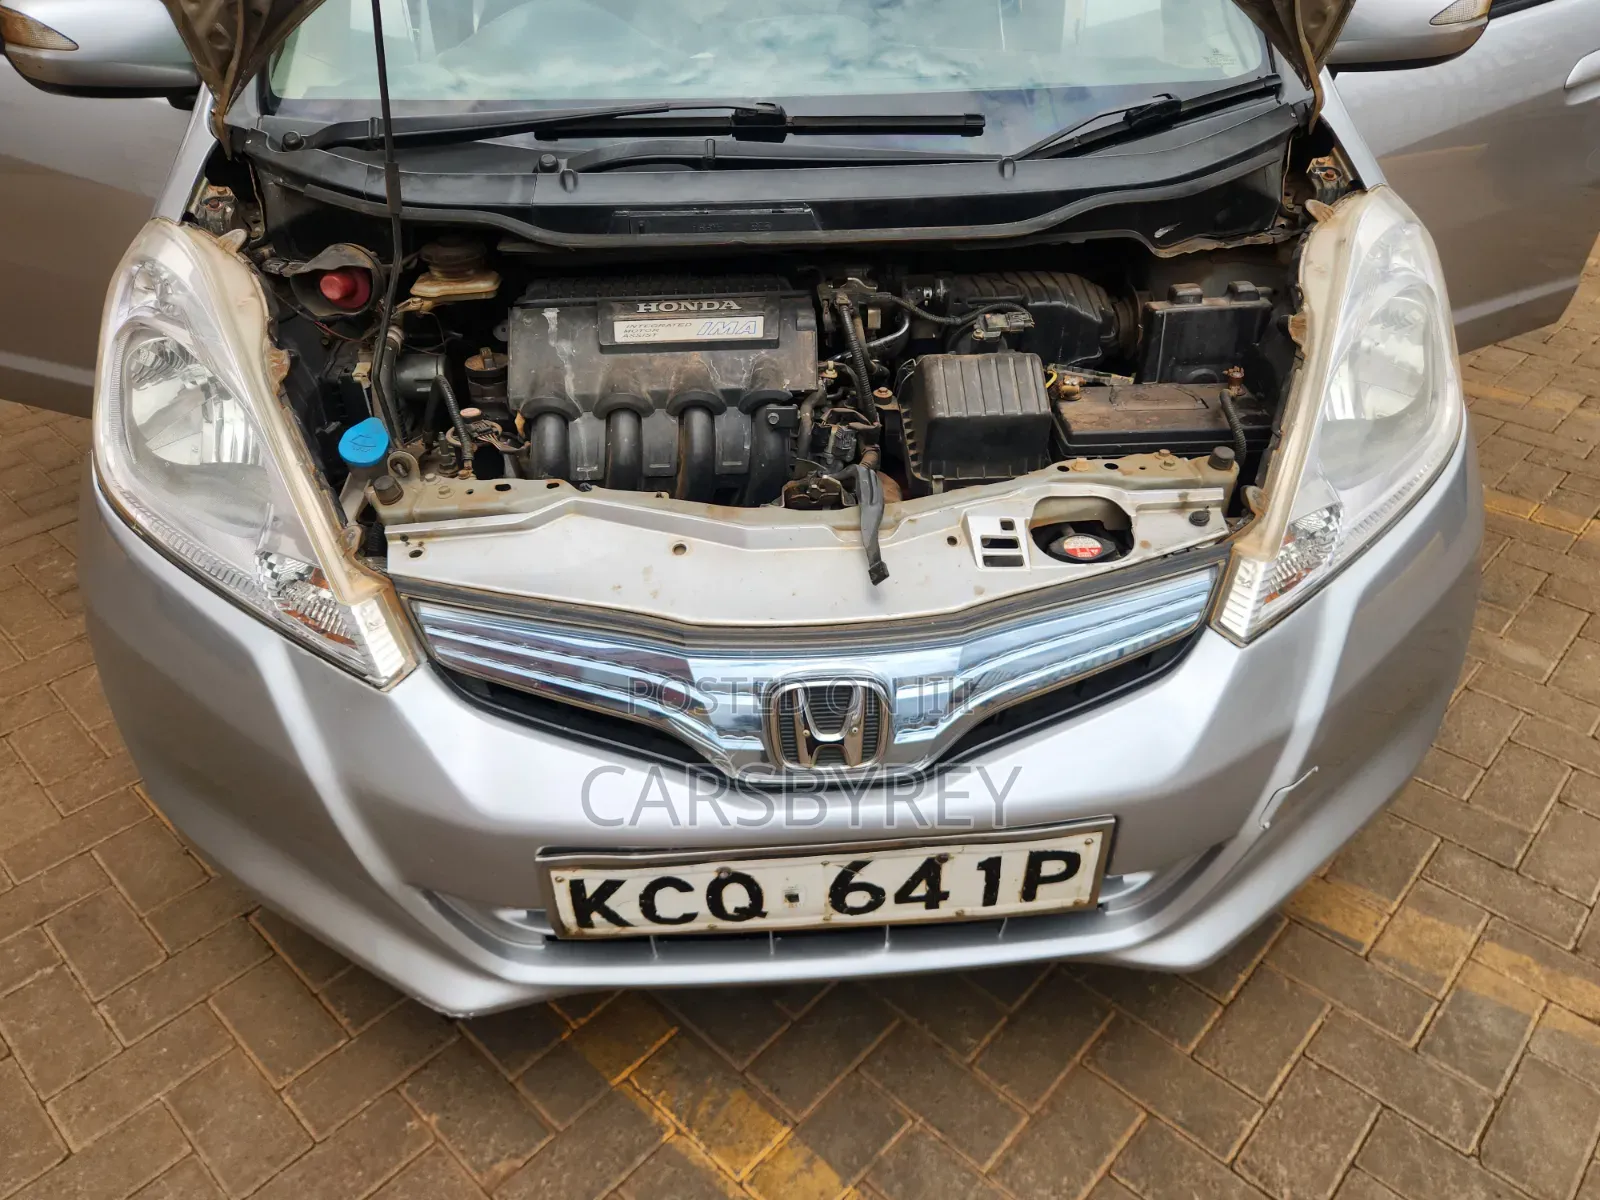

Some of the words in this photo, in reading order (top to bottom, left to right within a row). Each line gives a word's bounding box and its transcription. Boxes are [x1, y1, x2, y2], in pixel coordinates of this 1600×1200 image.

[637, 300, 742, 313] HONDA
[697, 320, 757, 336] IMA
[568, 868, 769, 929] KCQ
[829, 849, 1081, 916] 641P
